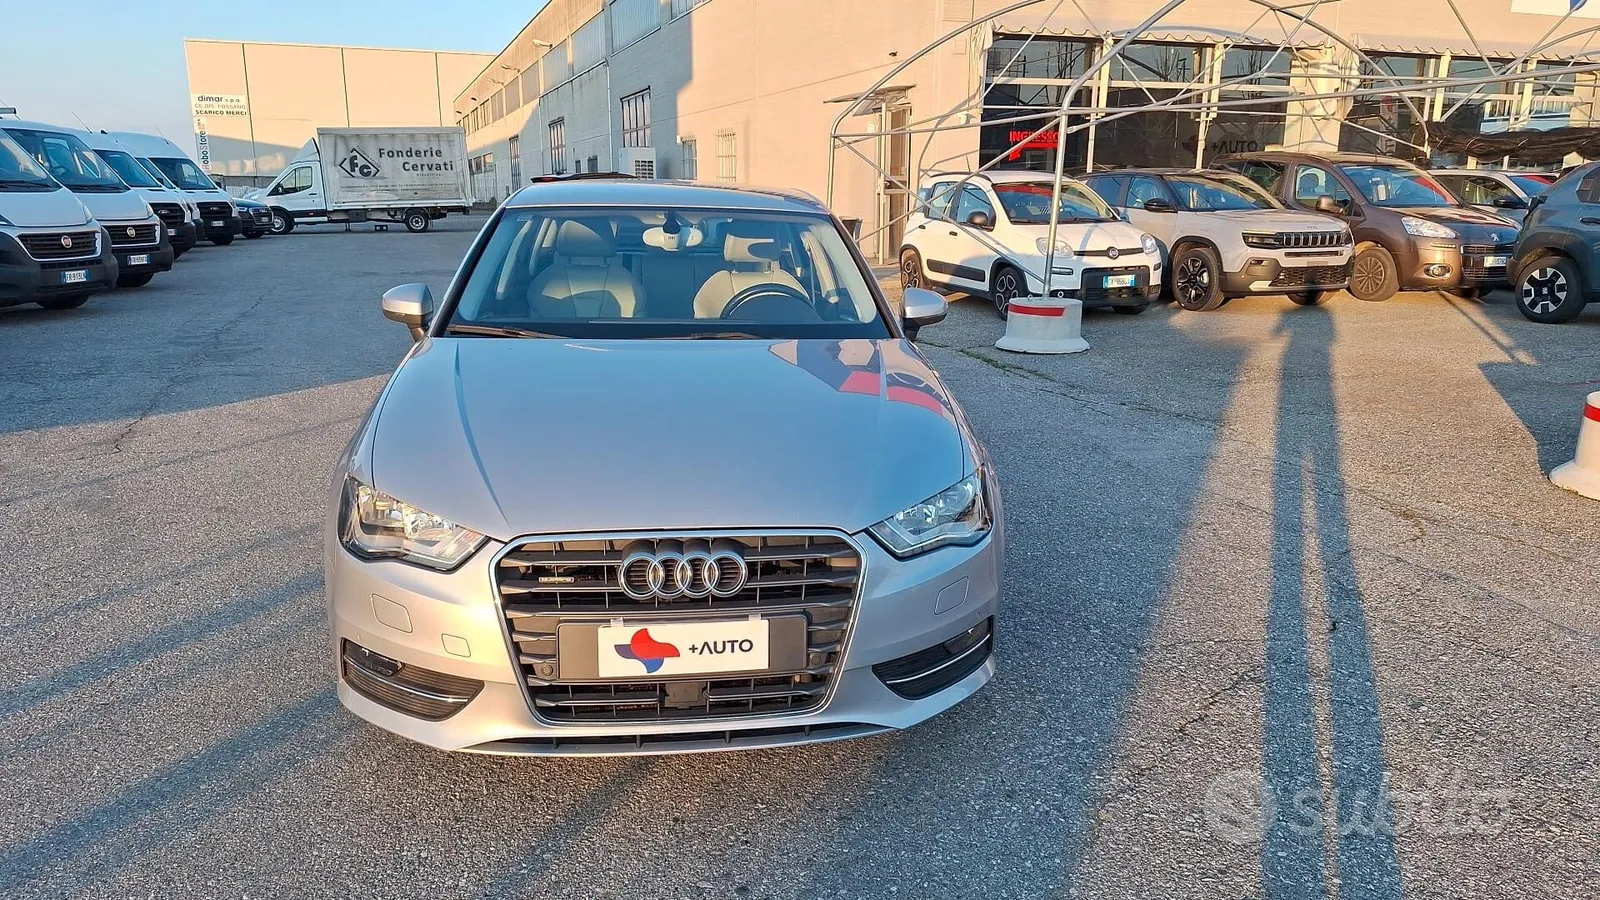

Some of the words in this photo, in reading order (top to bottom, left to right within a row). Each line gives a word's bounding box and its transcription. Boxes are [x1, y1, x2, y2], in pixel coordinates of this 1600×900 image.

[378, 147, 442, 159] Fonderie
[402, 160, 454, 172] Cervati
[688, 638, 754, 656] +AUTO
